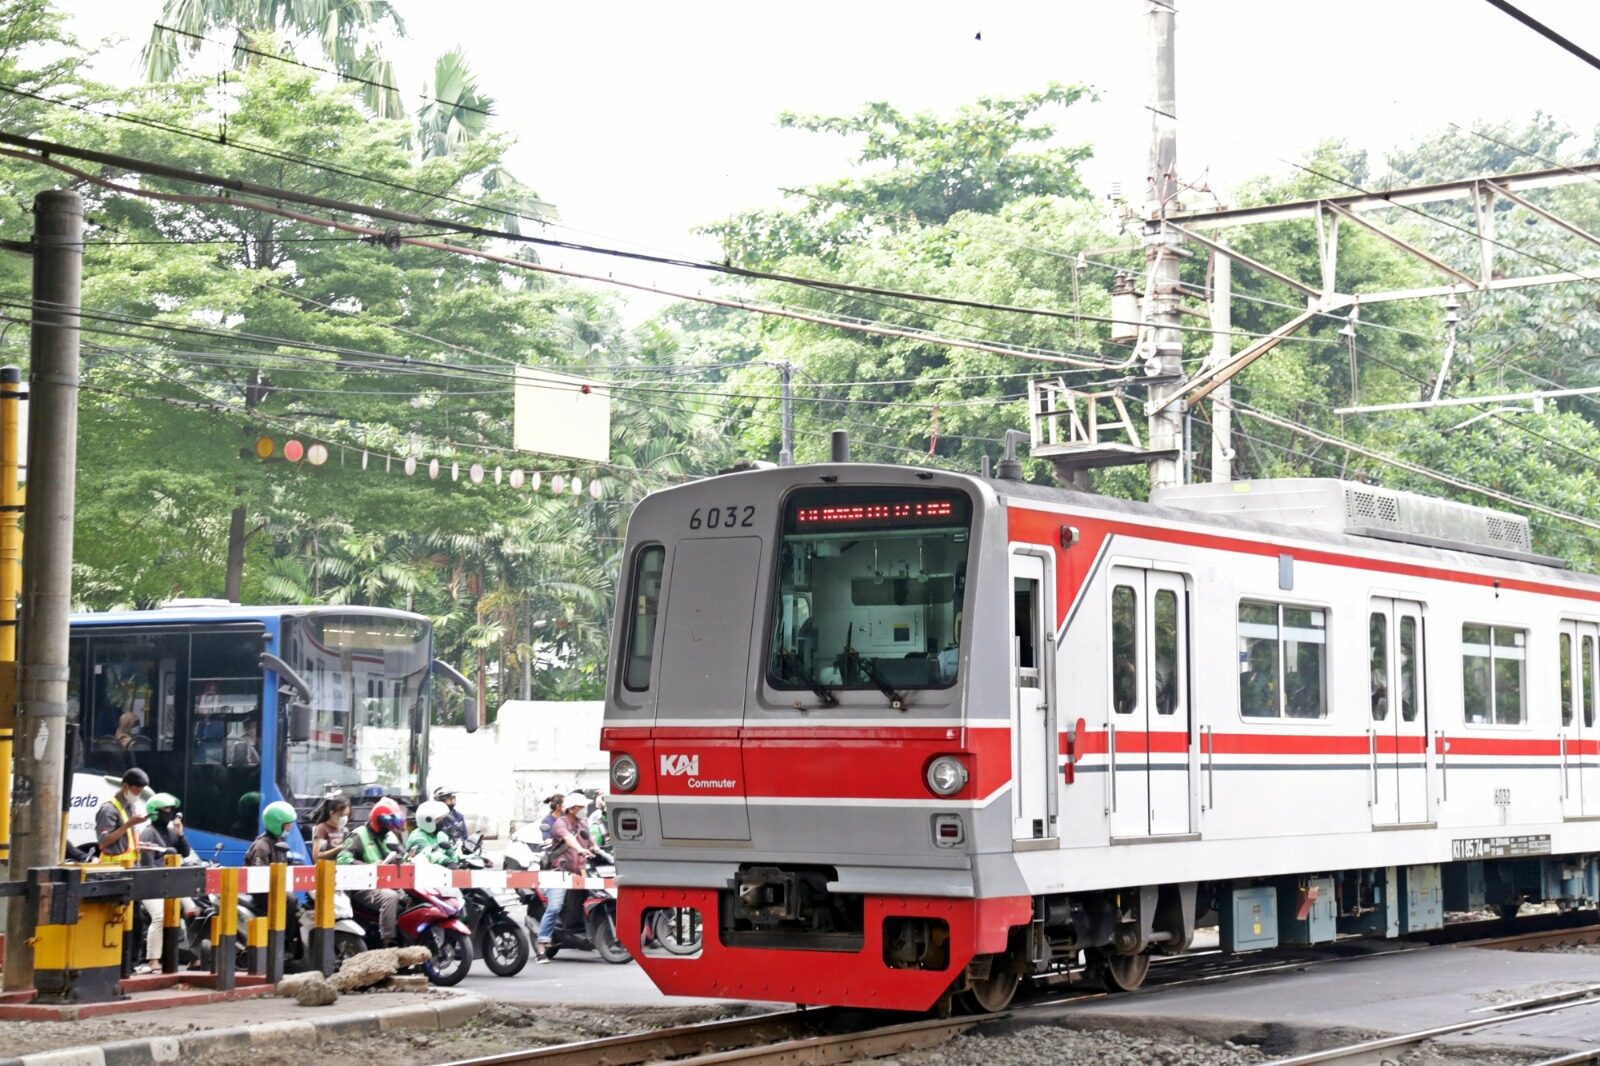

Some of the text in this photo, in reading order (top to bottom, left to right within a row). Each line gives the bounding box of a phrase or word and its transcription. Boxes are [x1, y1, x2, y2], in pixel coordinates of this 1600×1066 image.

[690, 505, 755, 530] 6032
[660, 754, 699, 776] KAI
[687, 777, 736, 789] Commuter
